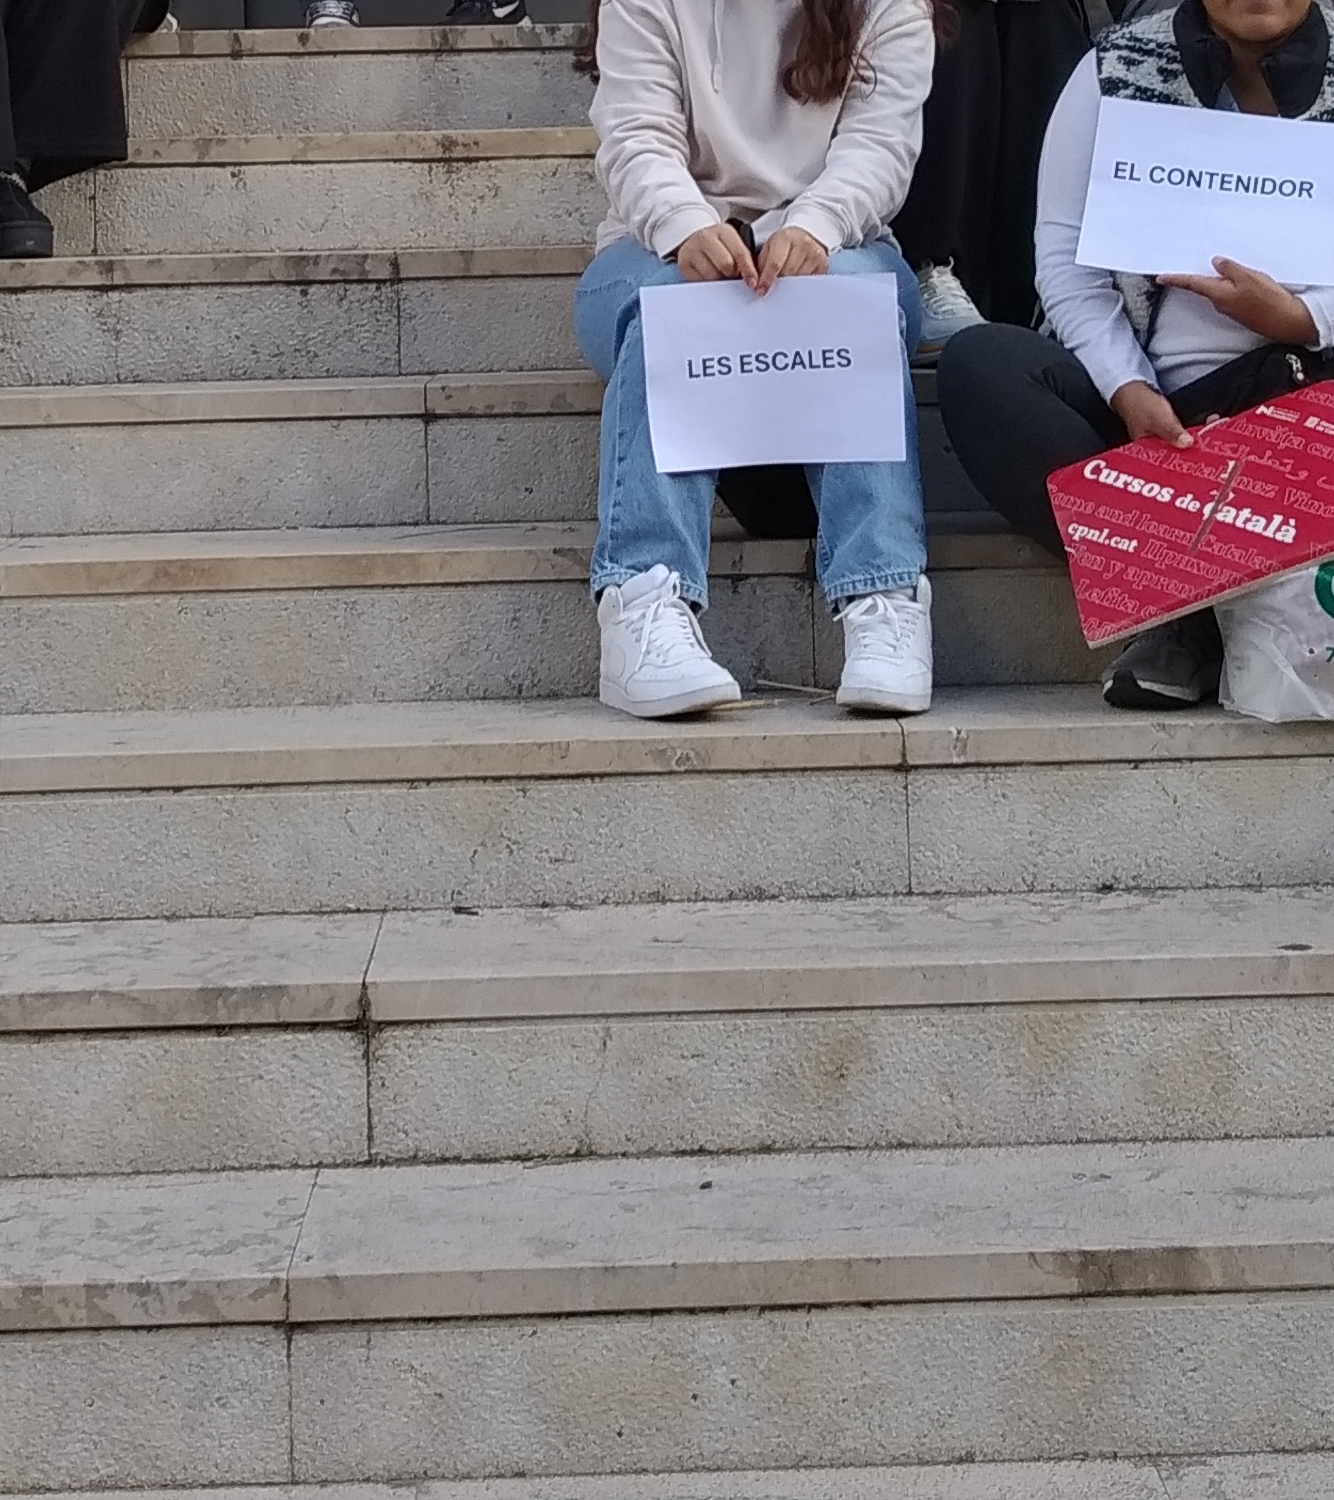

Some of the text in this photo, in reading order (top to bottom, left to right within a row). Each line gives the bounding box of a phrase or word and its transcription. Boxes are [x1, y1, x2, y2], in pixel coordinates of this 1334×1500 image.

[1113, 161, 1315, 199] EL CONTENIDOR
[687, 348, 852, 379] LES ESCALES
[1083, 460, 1175, 503] Cursos
[1175, 494, 1200, 512] de
[1068, 523, 1138, 553] cpnl.cat
[1095, 504, 1136, 527] and
[1136, 514, 1196, 546] learn
[1103, 561, 1125, 580] y
